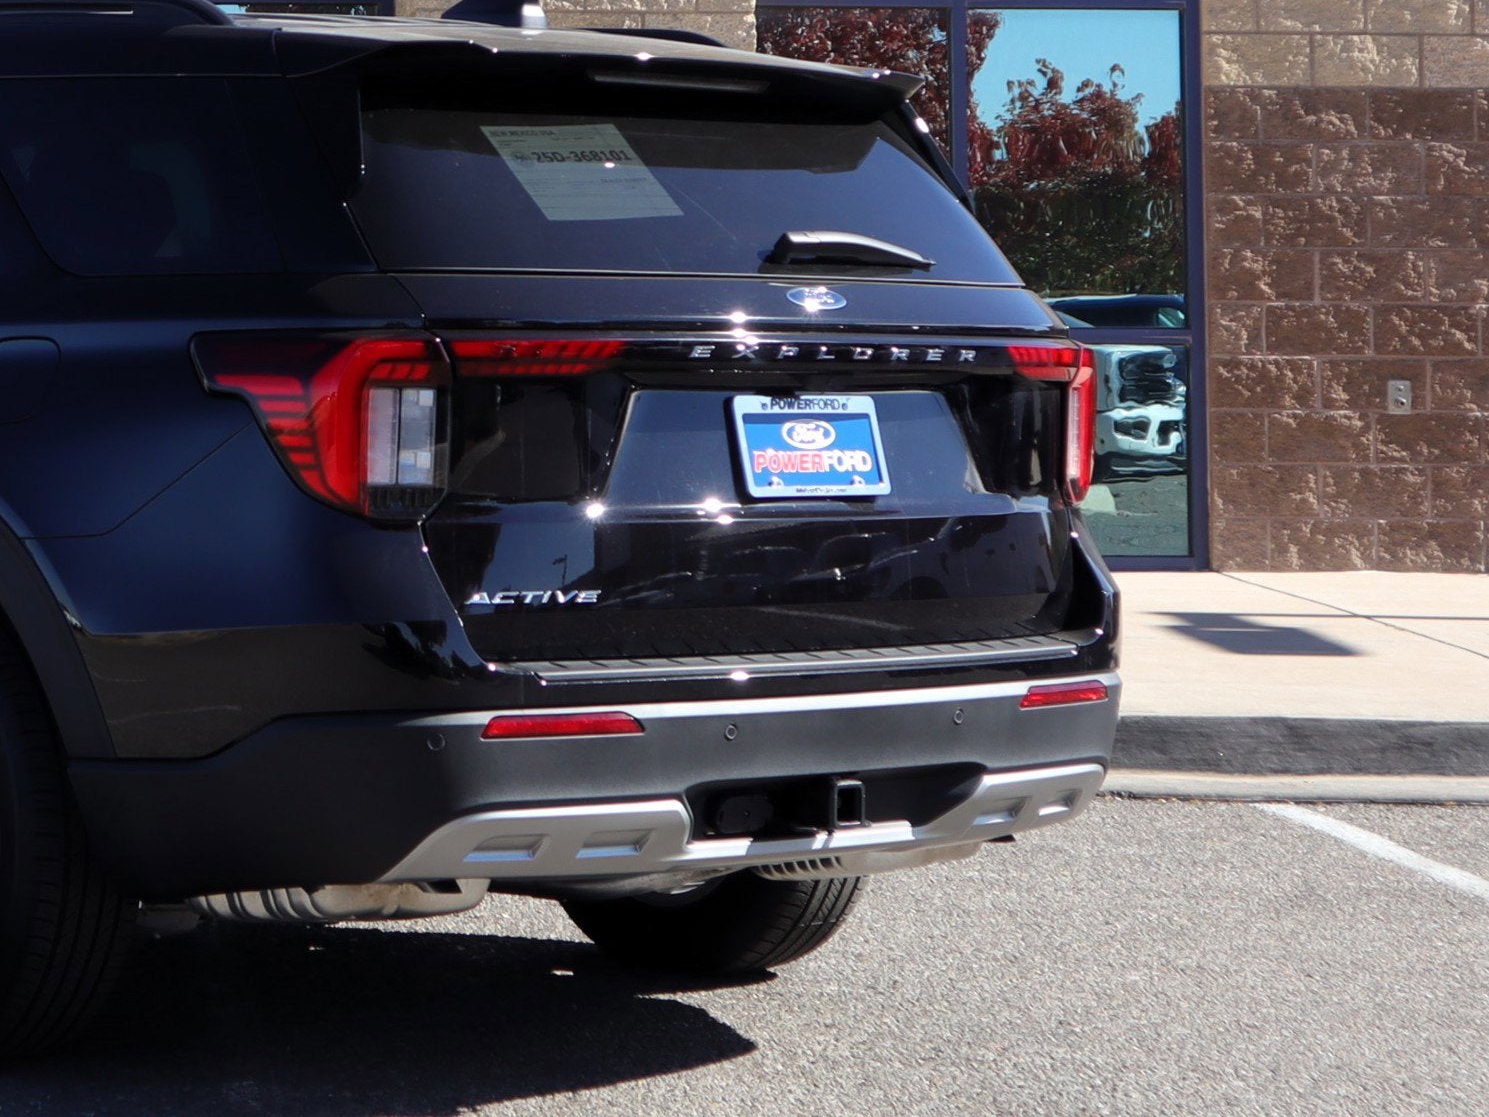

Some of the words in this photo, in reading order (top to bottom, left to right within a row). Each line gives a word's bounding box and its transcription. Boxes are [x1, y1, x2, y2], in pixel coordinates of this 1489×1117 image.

[530, 149, 633, 164] 25D-368101
[688, 344, 977, 363] EXPLORER
[769, 398, 841, 411] POWERFORD
[752, 448, 873, 474] POWERFORD
[464, 589, 602, 605] ACTIVE
